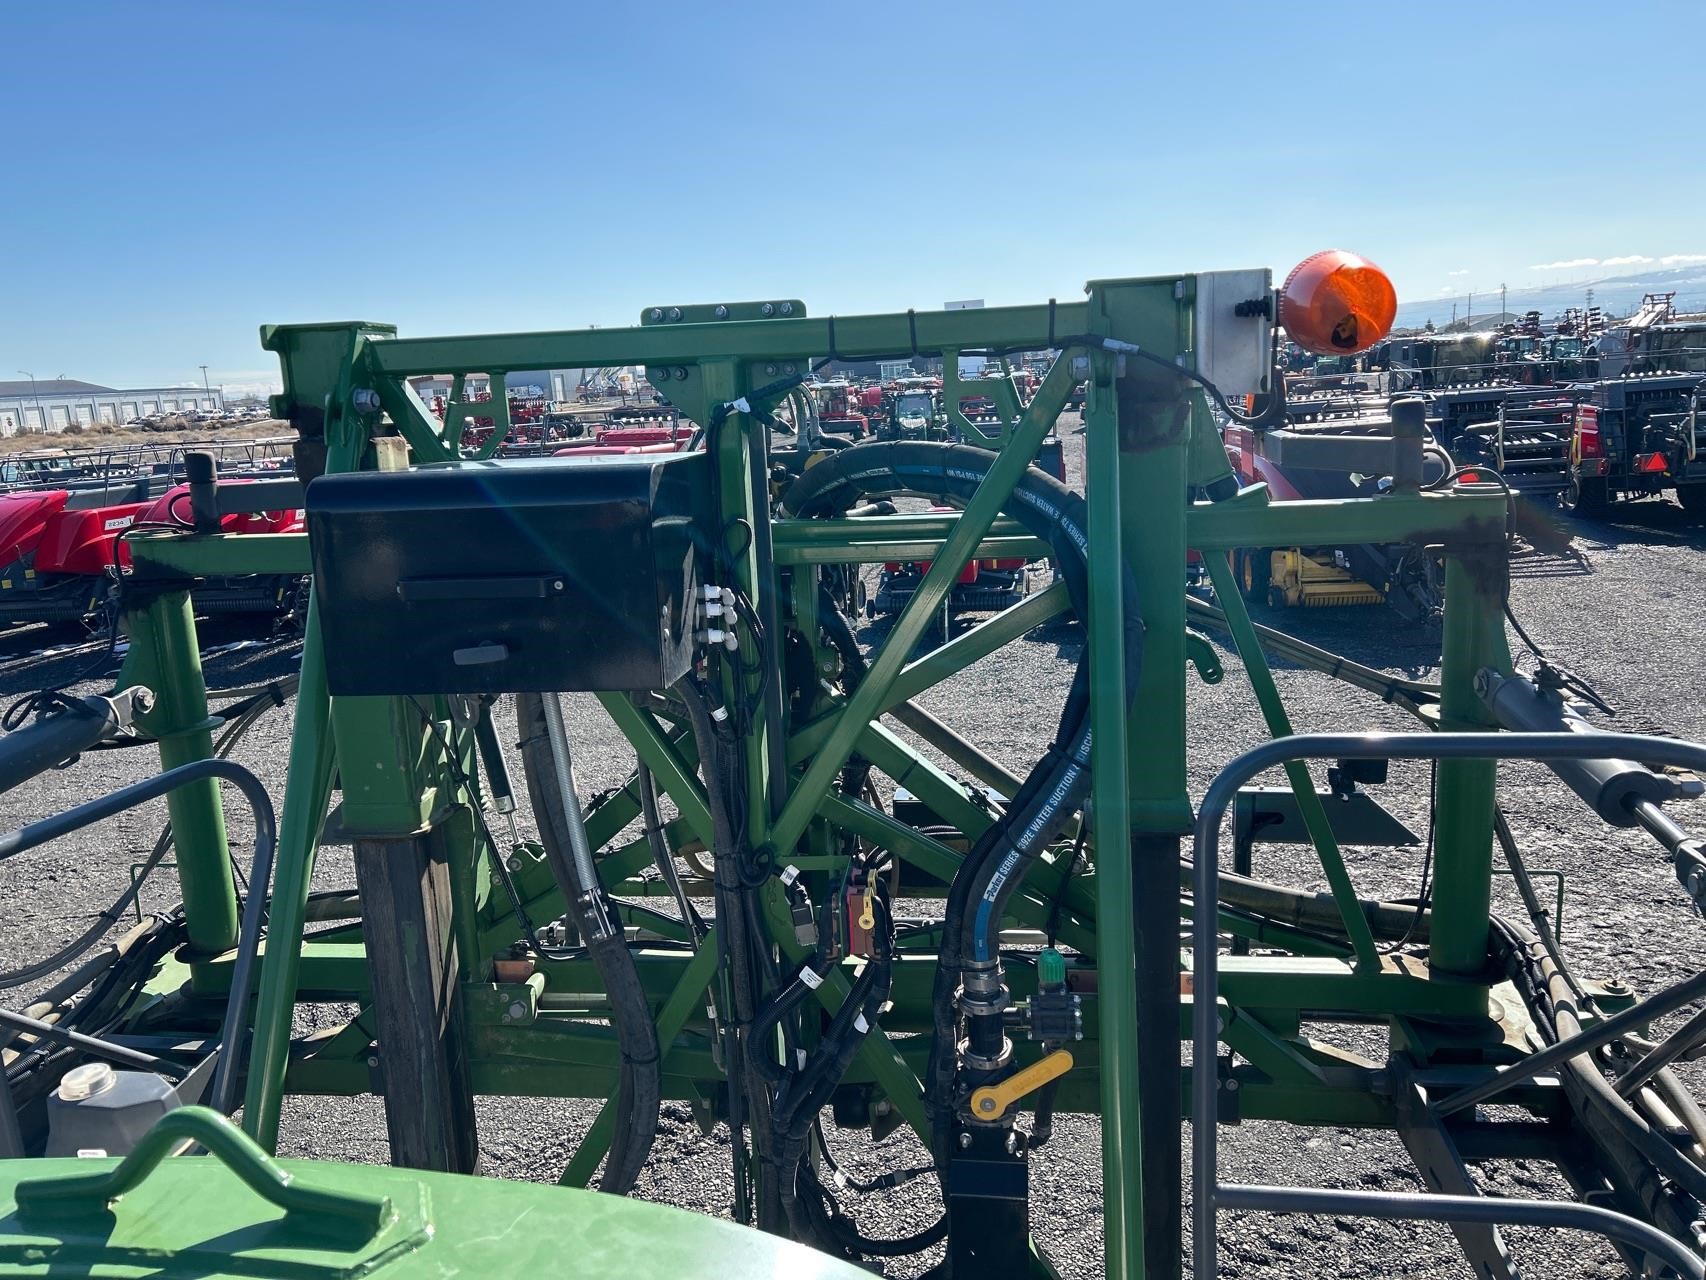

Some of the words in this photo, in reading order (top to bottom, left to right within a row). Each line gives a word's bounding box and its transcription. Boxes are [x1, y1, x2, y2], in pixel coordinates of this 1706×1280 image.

[1036, 497, 1054, 516] WATER
[986, 872, 1006, 900] Parker
[999, 849, 1020, 875] SERIES
[1030, 804, 1054, 832] WATER
[1049, 769, 1077, 806] SUCTION
[1076, 728, 1093, 761] DISCH
